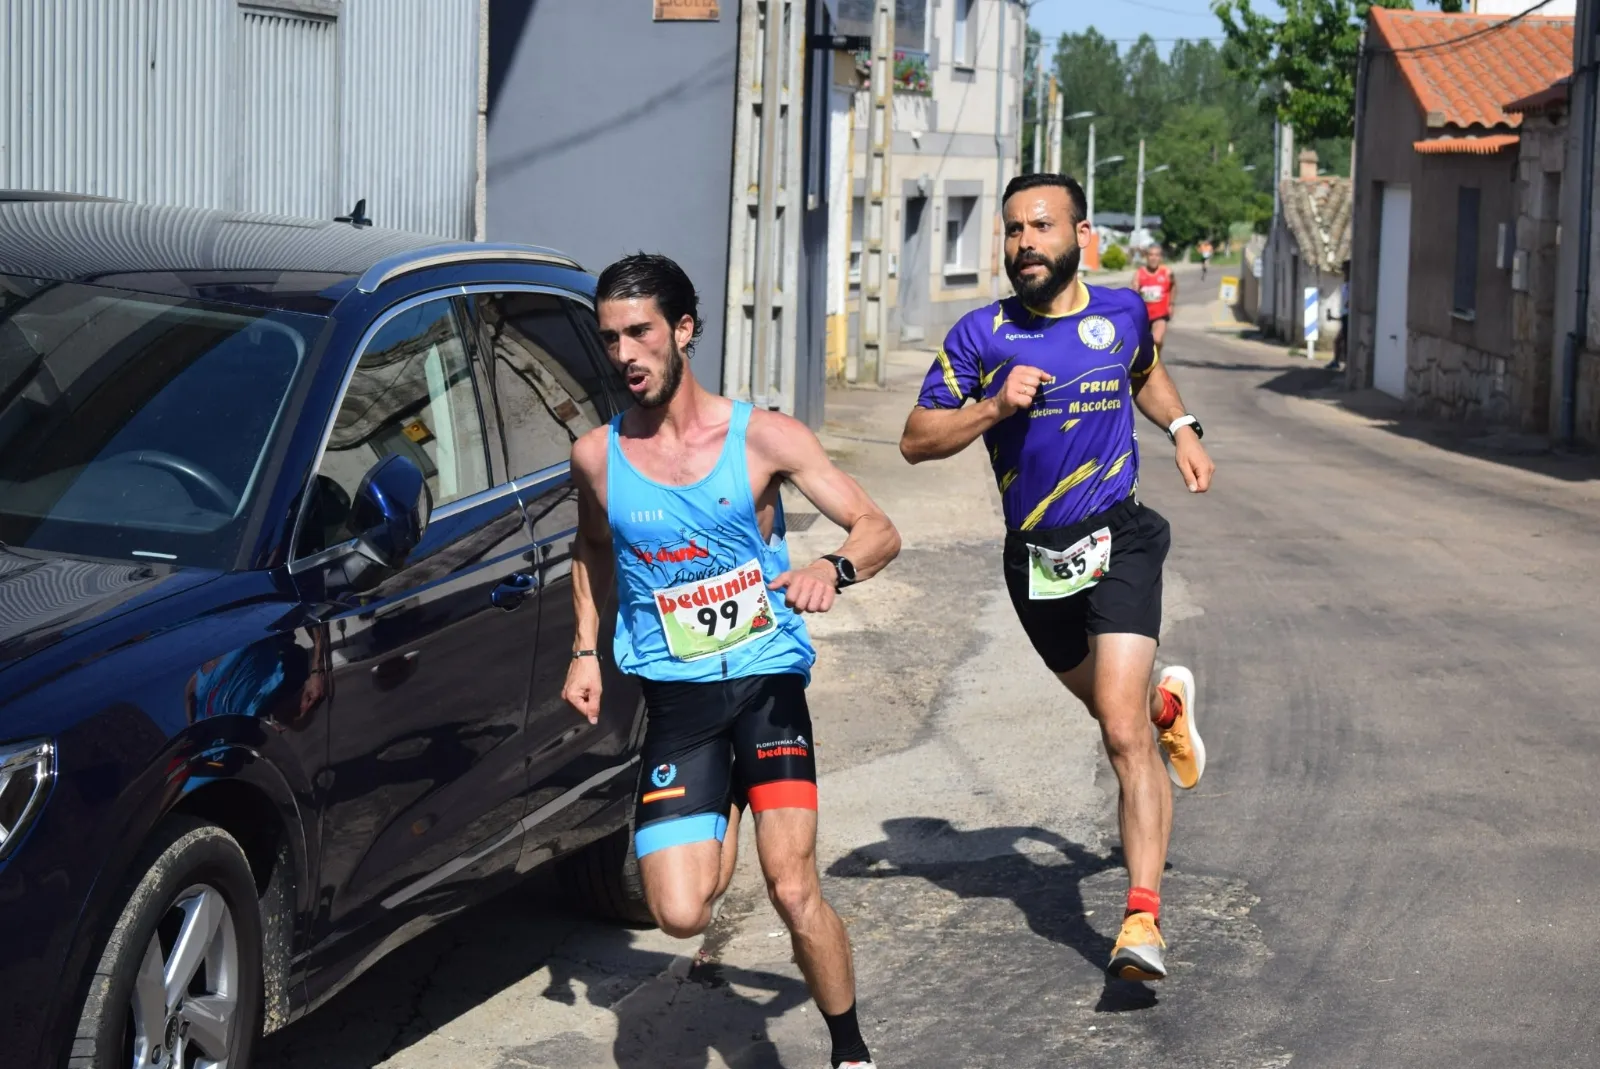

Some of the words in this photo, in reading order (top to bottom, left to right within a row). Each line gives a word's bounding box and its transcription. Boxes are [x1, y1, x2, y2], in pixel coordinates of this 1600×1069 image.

[1080, 379, 1119, 393] PRIM
[1069, 398, 1121, 413] Macotera
[1053, 551, 1086, 579] 85
[657, 568, 762, 615] bedunia
[697, 600, 739, 636] 99
[757, 746, 807, 759] bedunia
